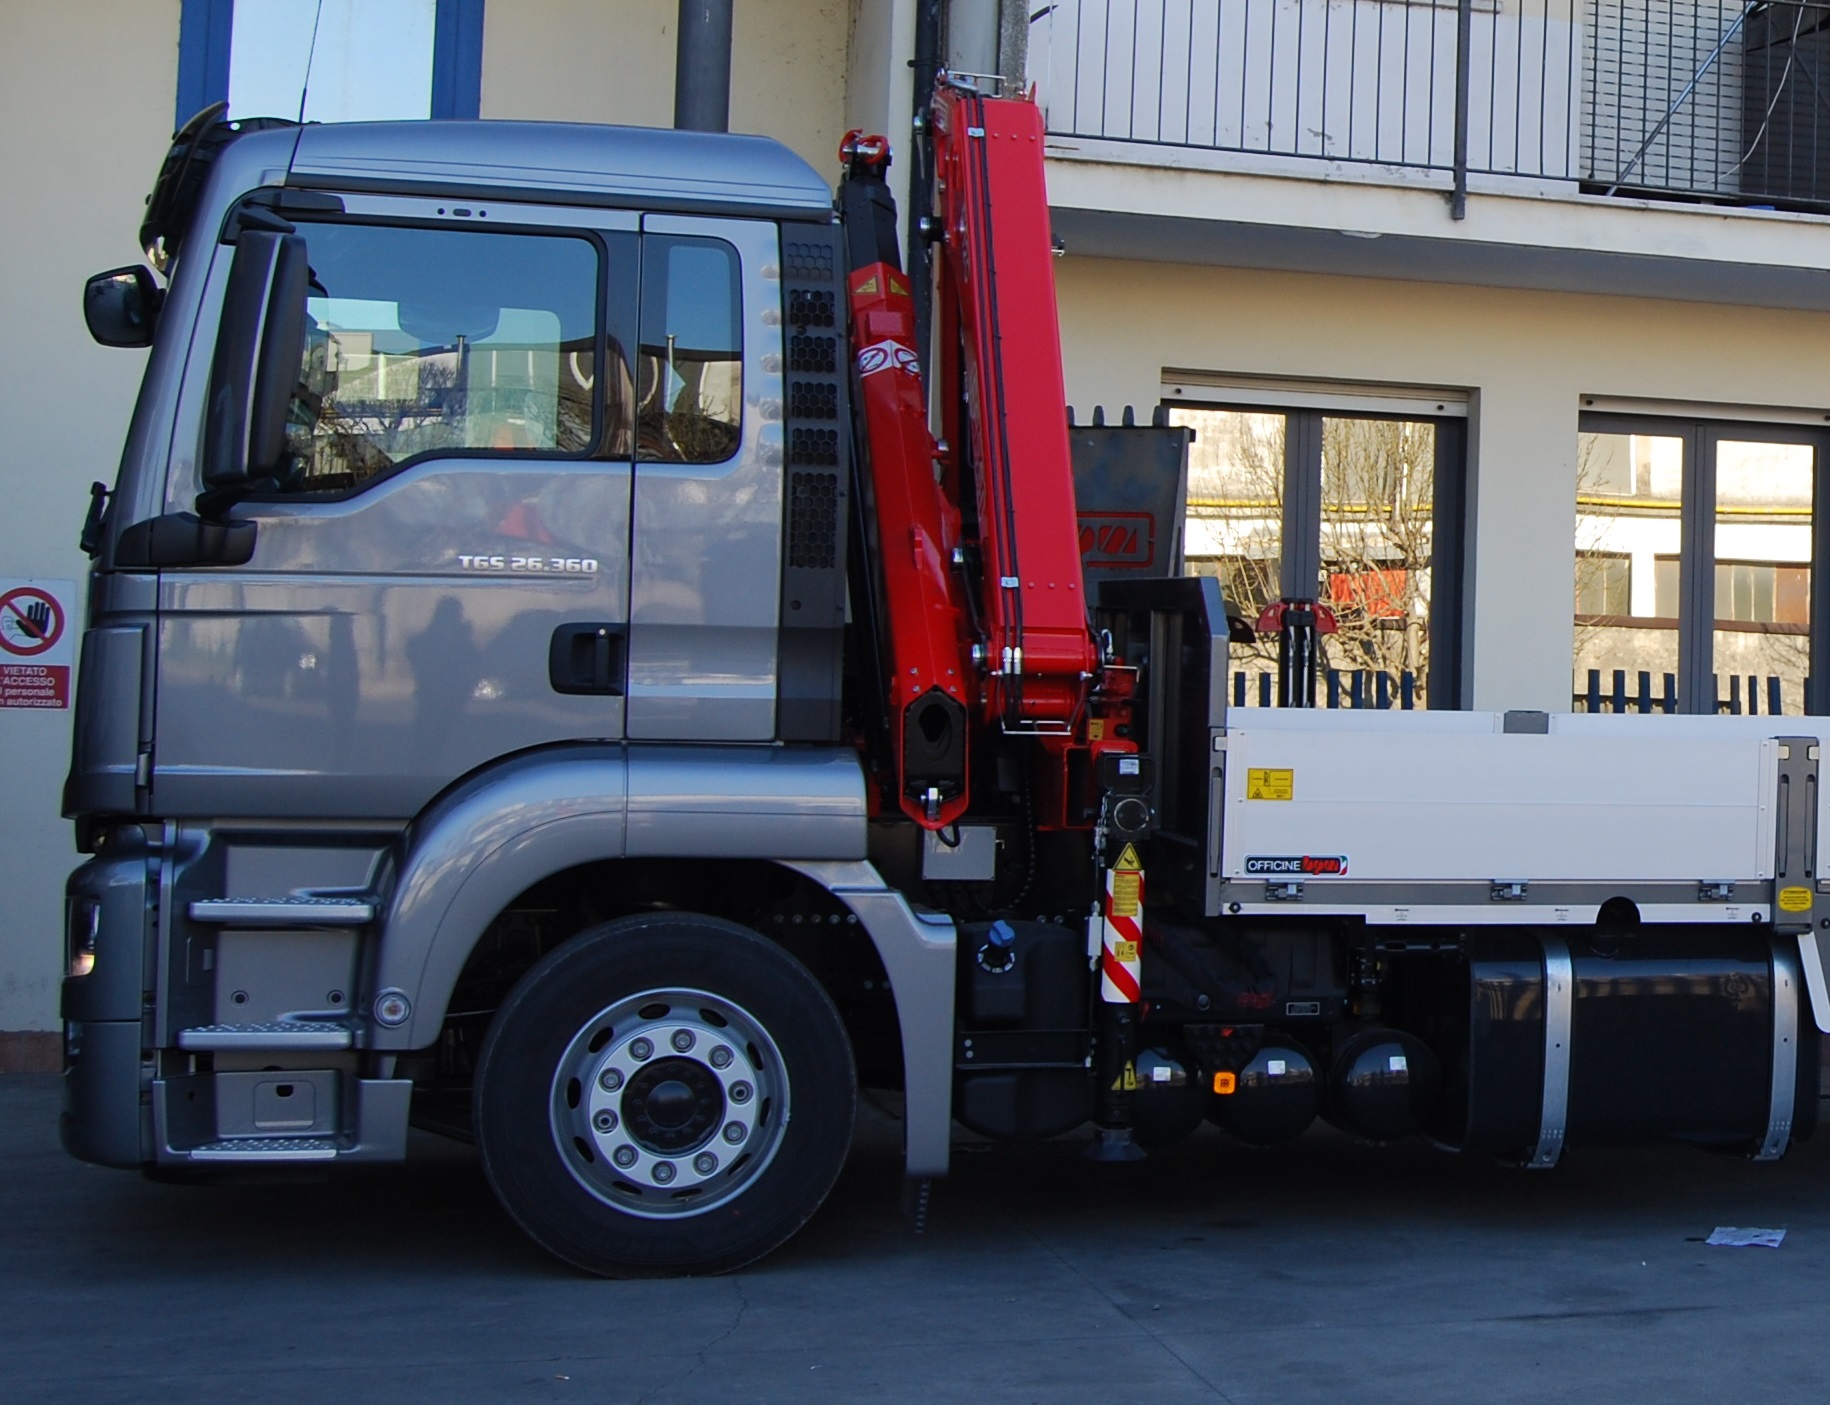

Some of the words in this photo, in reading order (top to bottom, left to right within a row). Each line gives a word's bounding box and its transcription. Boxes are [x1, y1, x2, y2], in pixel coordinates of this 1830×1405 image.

[459, 555, 504, 570] TGS
[511, 557, 598, 573] 26.360
[3, 666, 47, 676] VIETATO
[0, 676, 55, 686] 'ACCESSO
[5, 687, 55, 697] personale
[6, 698, 63, 707] autorizzato
[1248, 860, 1300, 871] OFFICINE
